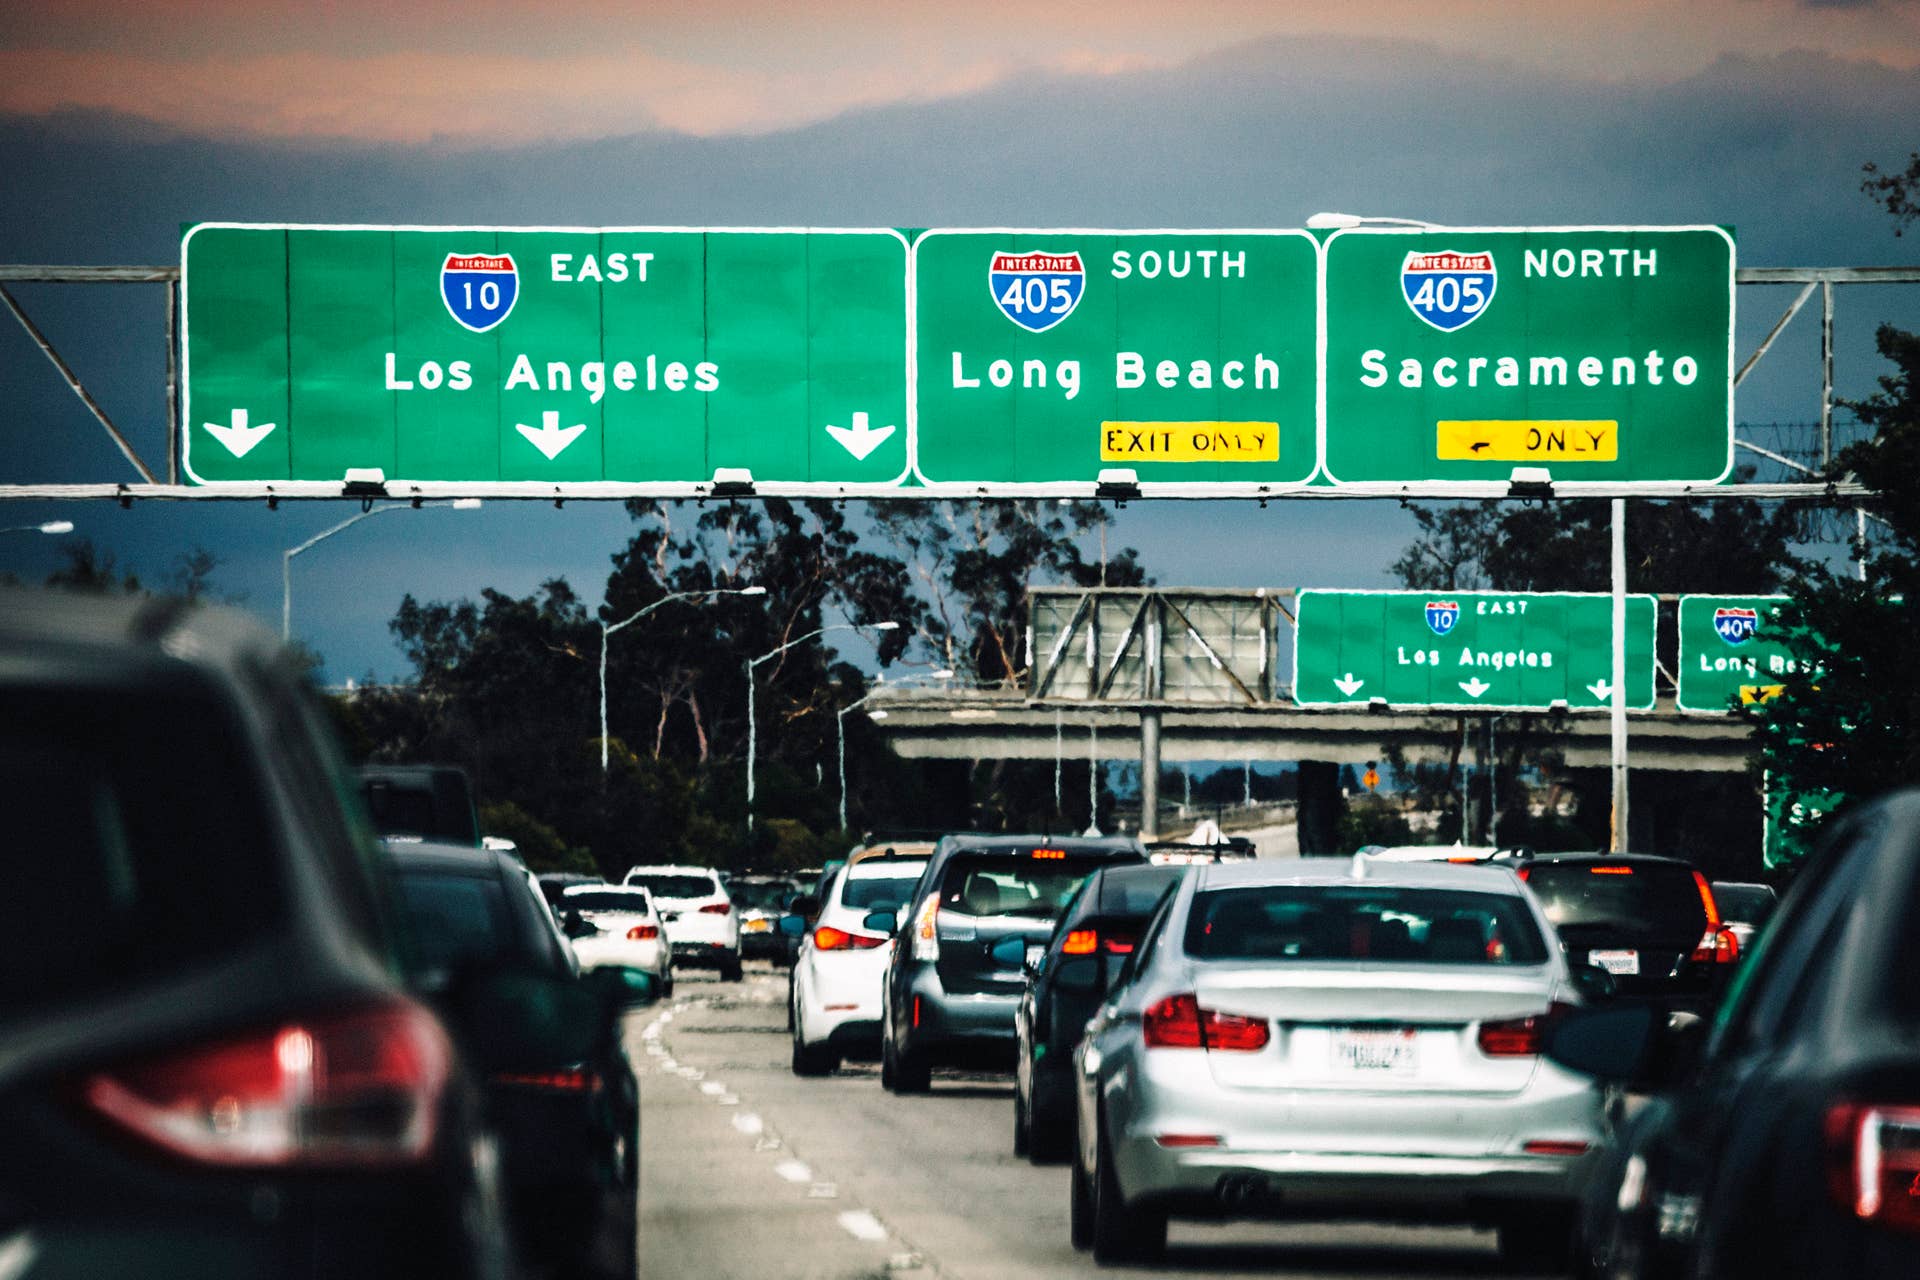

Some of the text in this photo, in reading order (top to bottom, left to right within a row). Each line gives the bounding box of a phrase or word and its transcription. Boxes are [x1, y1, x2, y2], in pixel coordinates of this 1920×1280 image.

[551, 253, 654, 283] EAST
[1001, 259, 1072, 270] INTERSTATE
[1111, 250, 1246, 279] SOUTH
[1412, 257, 1486, 269] INTERSTATE
[1524, 248, 1657, 278] NORTH
[463, 281, 500, 310] 10
[1000, 277, 1073, 314] 405
[1412, 277, 1485, 314] 405
[385, 352, 720, 404] Los Angeles
[952, 351, 1280, 400] Long Beach
[1359, 349, 1698, 388] Sacramento
[1107, 429, 1265, 452] EXIT ONLY
[1526, 427, 1606, 452] ONLY
[1434, 611, 1453, 629] 10
[1477, 600, 1528, 615] EAST
[1397, 646, 1552, 671] Los Angeles
